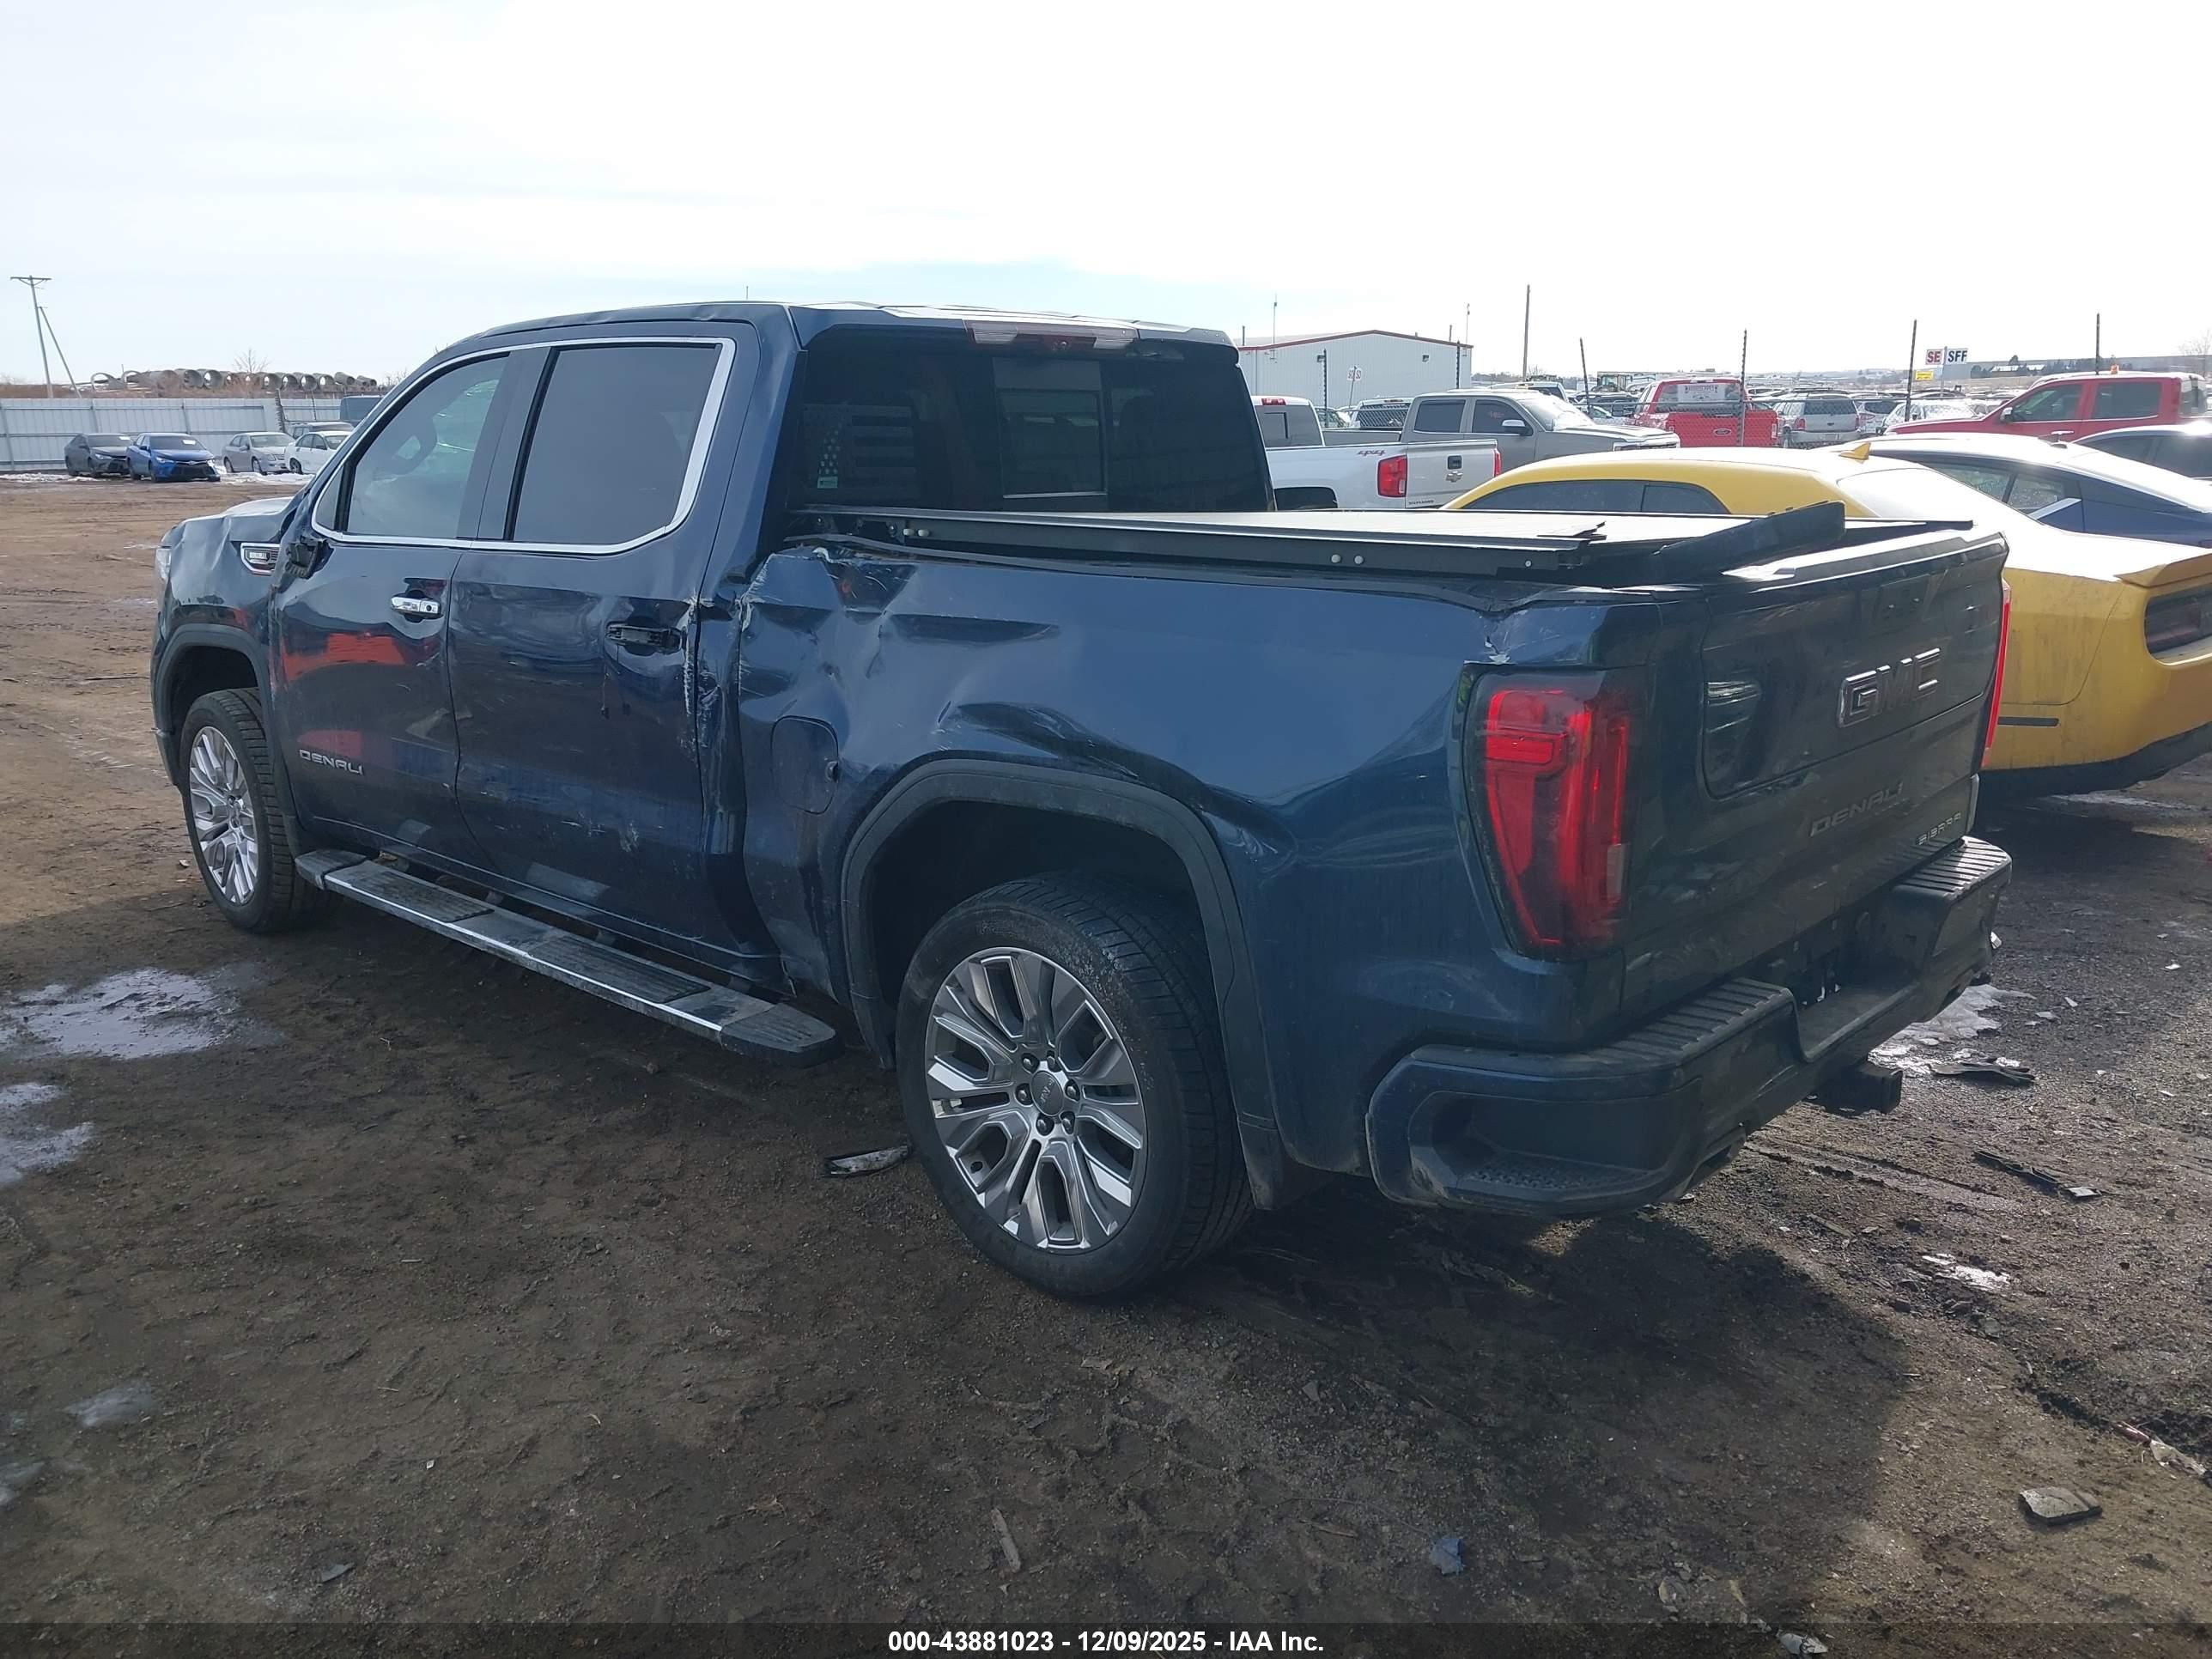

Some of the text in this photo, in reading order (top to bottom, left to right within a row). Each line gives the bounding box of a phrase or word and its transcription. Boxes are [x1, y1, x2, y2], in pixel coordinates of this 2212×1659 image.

[1927, 350, 1941, 363] SE
[1948, 350, 1968, 362] SFF
[1836, 647, 1942, 728] GMC
[298, 749, 363, 775] DENALI
[1809, 781, 1904, 836] DENALI
